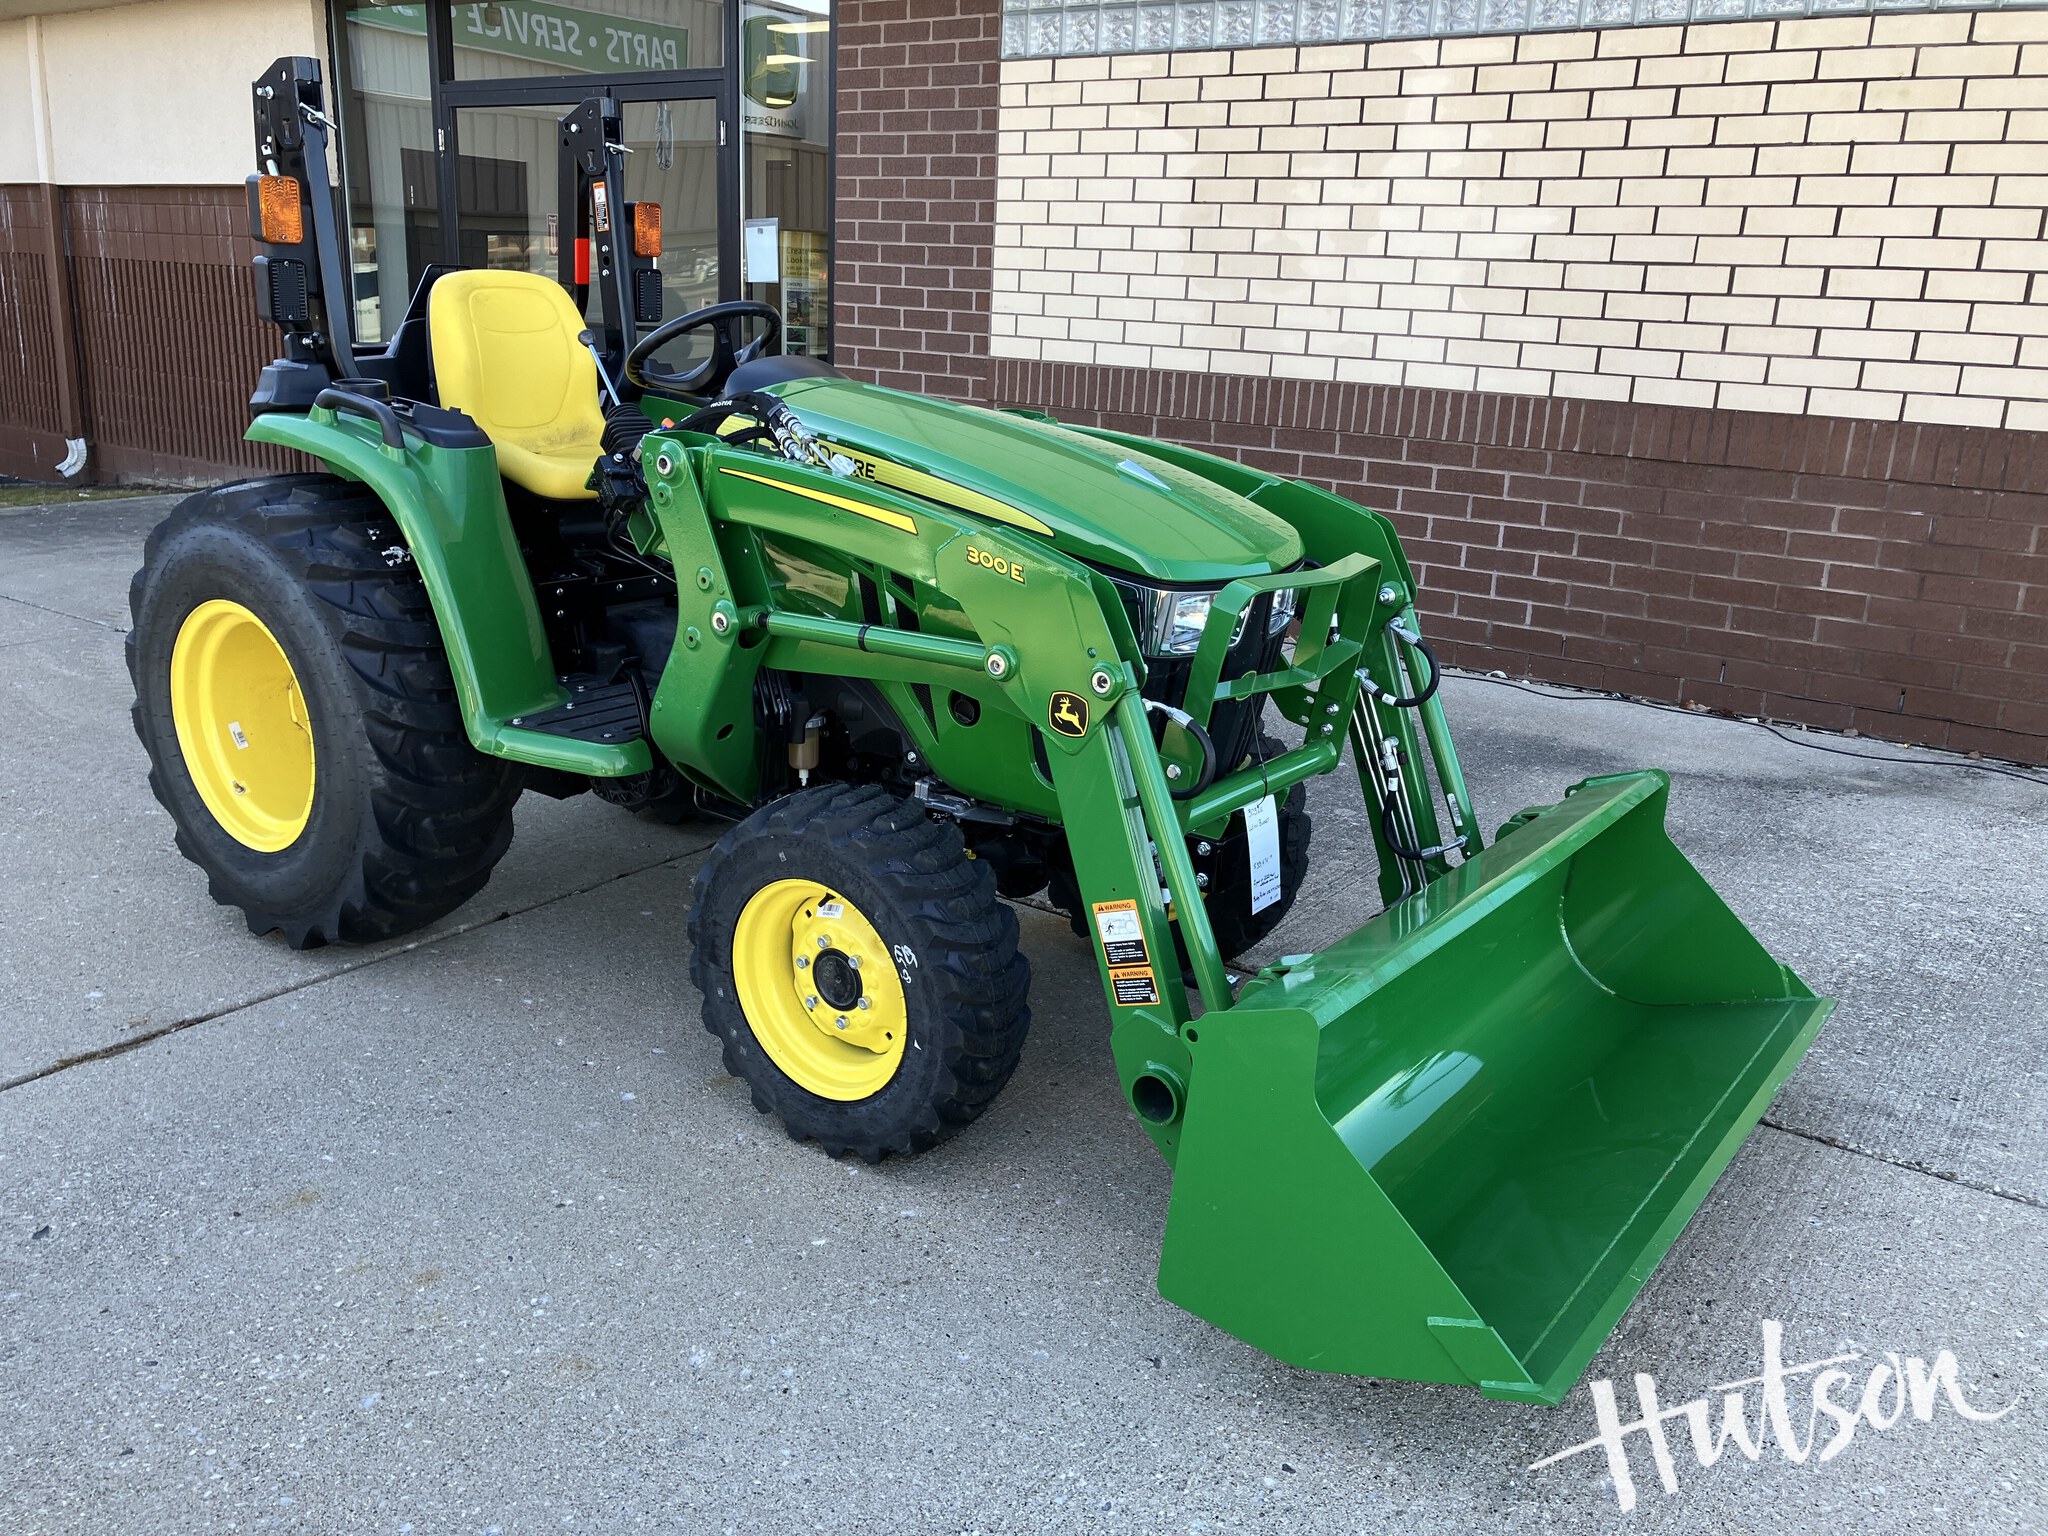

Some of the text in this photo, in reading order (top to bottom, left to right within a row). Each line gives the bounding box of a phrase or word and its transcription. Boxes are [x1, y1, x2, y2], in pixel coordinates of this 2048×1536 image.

[966, 545, 1025, 585] 300E
[1104, 903, 1131, 911] WARNING
[1121, 970, 1148, 978] WARNING
